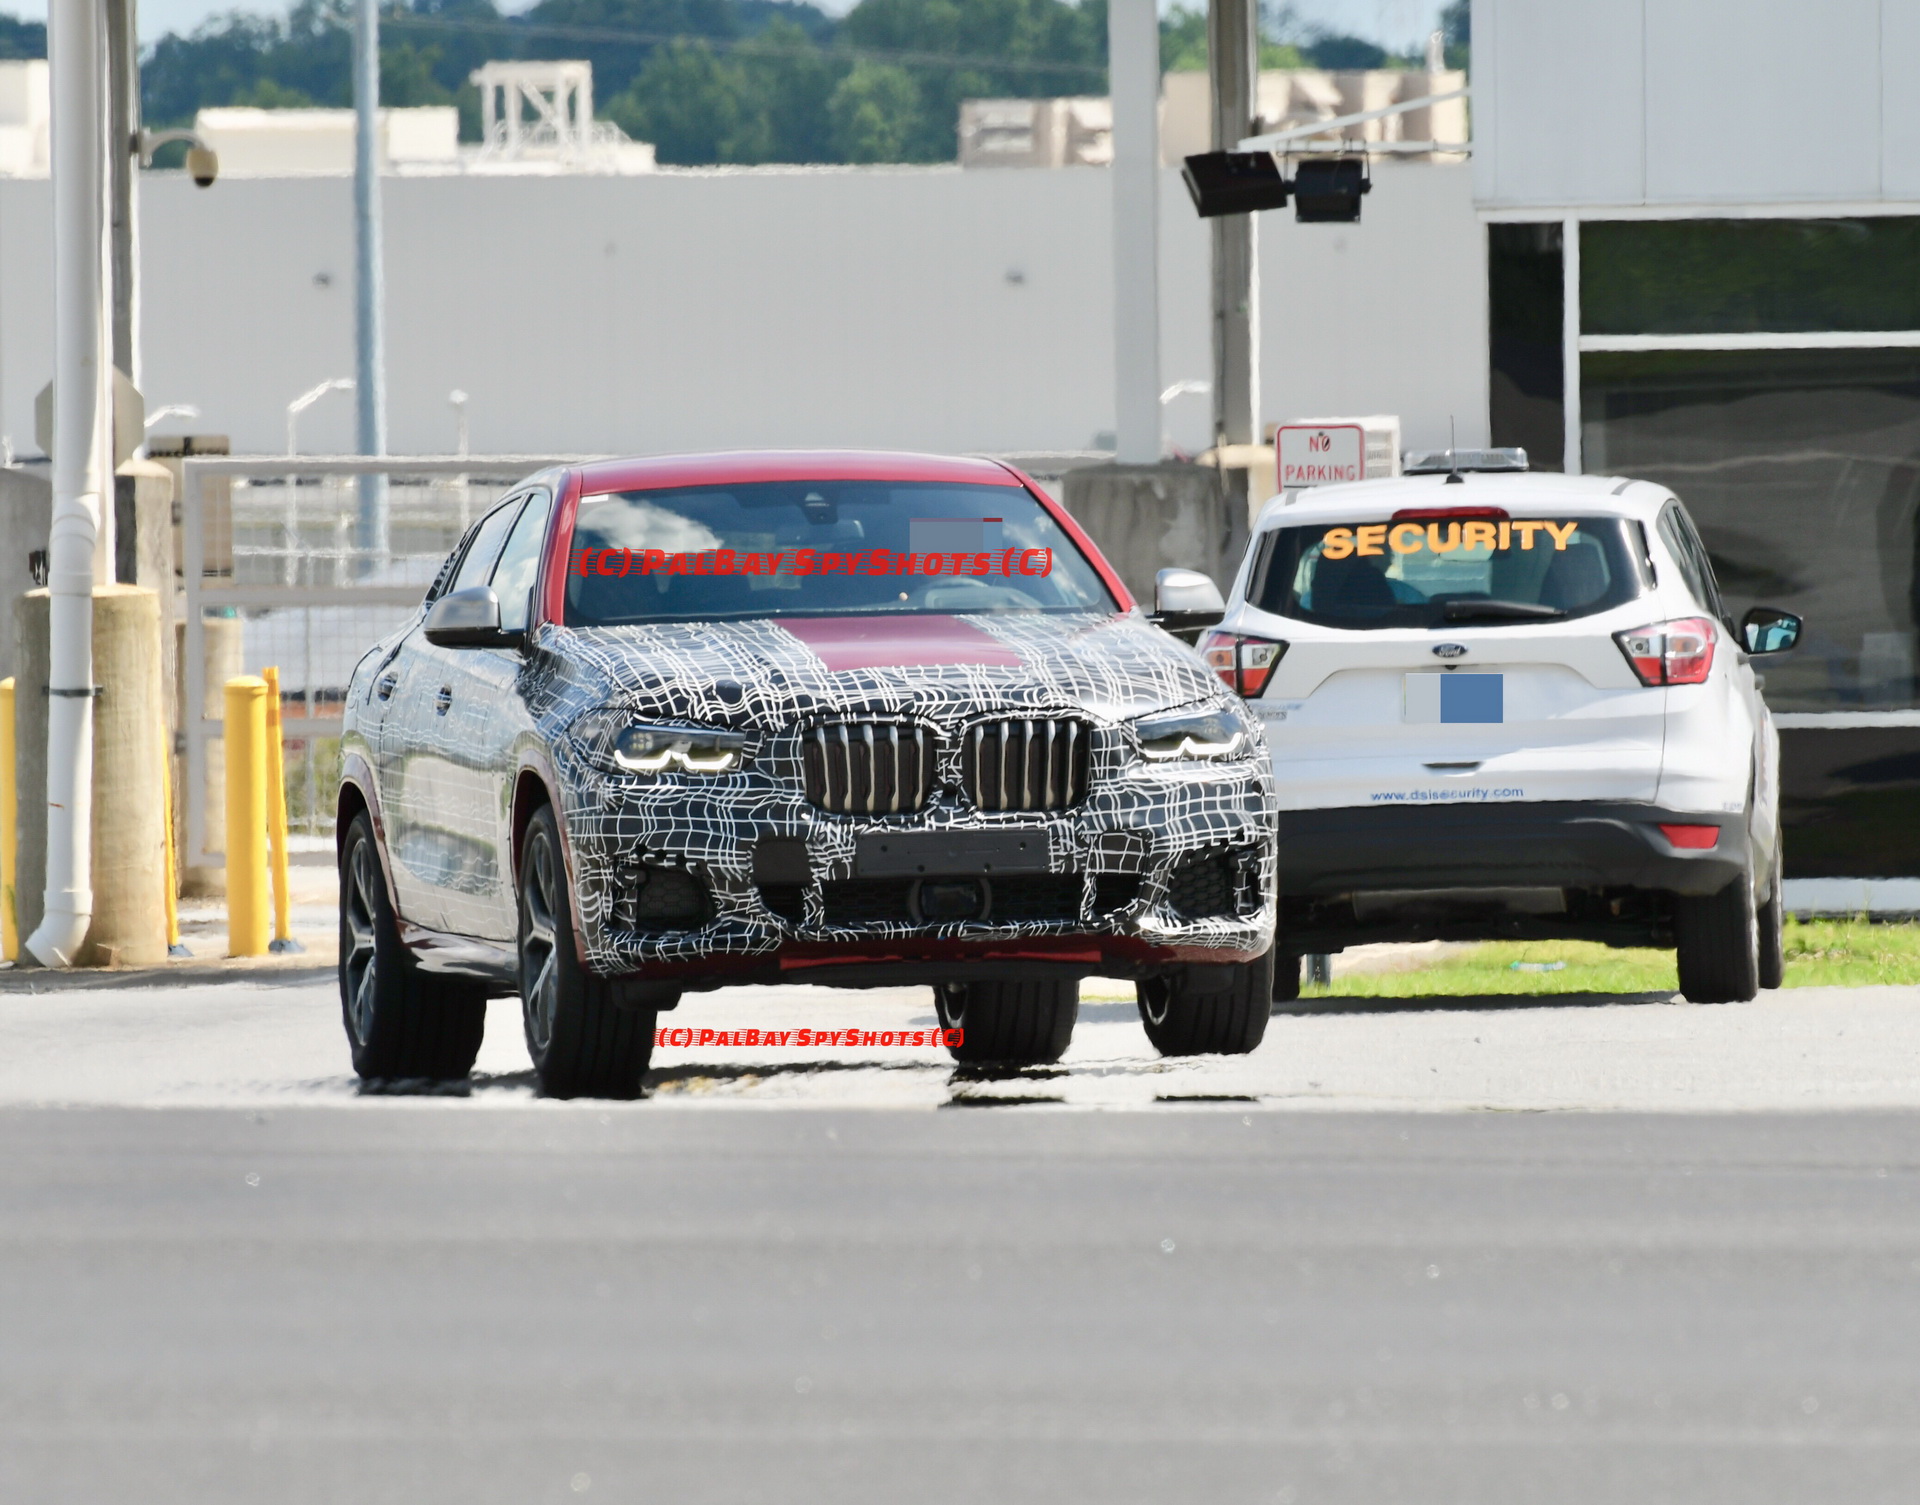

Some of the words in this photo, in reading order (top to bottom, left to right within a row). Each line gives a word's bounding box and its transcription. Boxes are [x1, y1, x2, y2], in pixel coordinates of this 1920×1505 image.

[1308, 435, 1331, 452] NO
[1285, 464, 1356, 482] PARKING
[1321, 520, 1579, 560] SECURITY
[1370, 787, 1524, 801] www.dsisecurity.com
